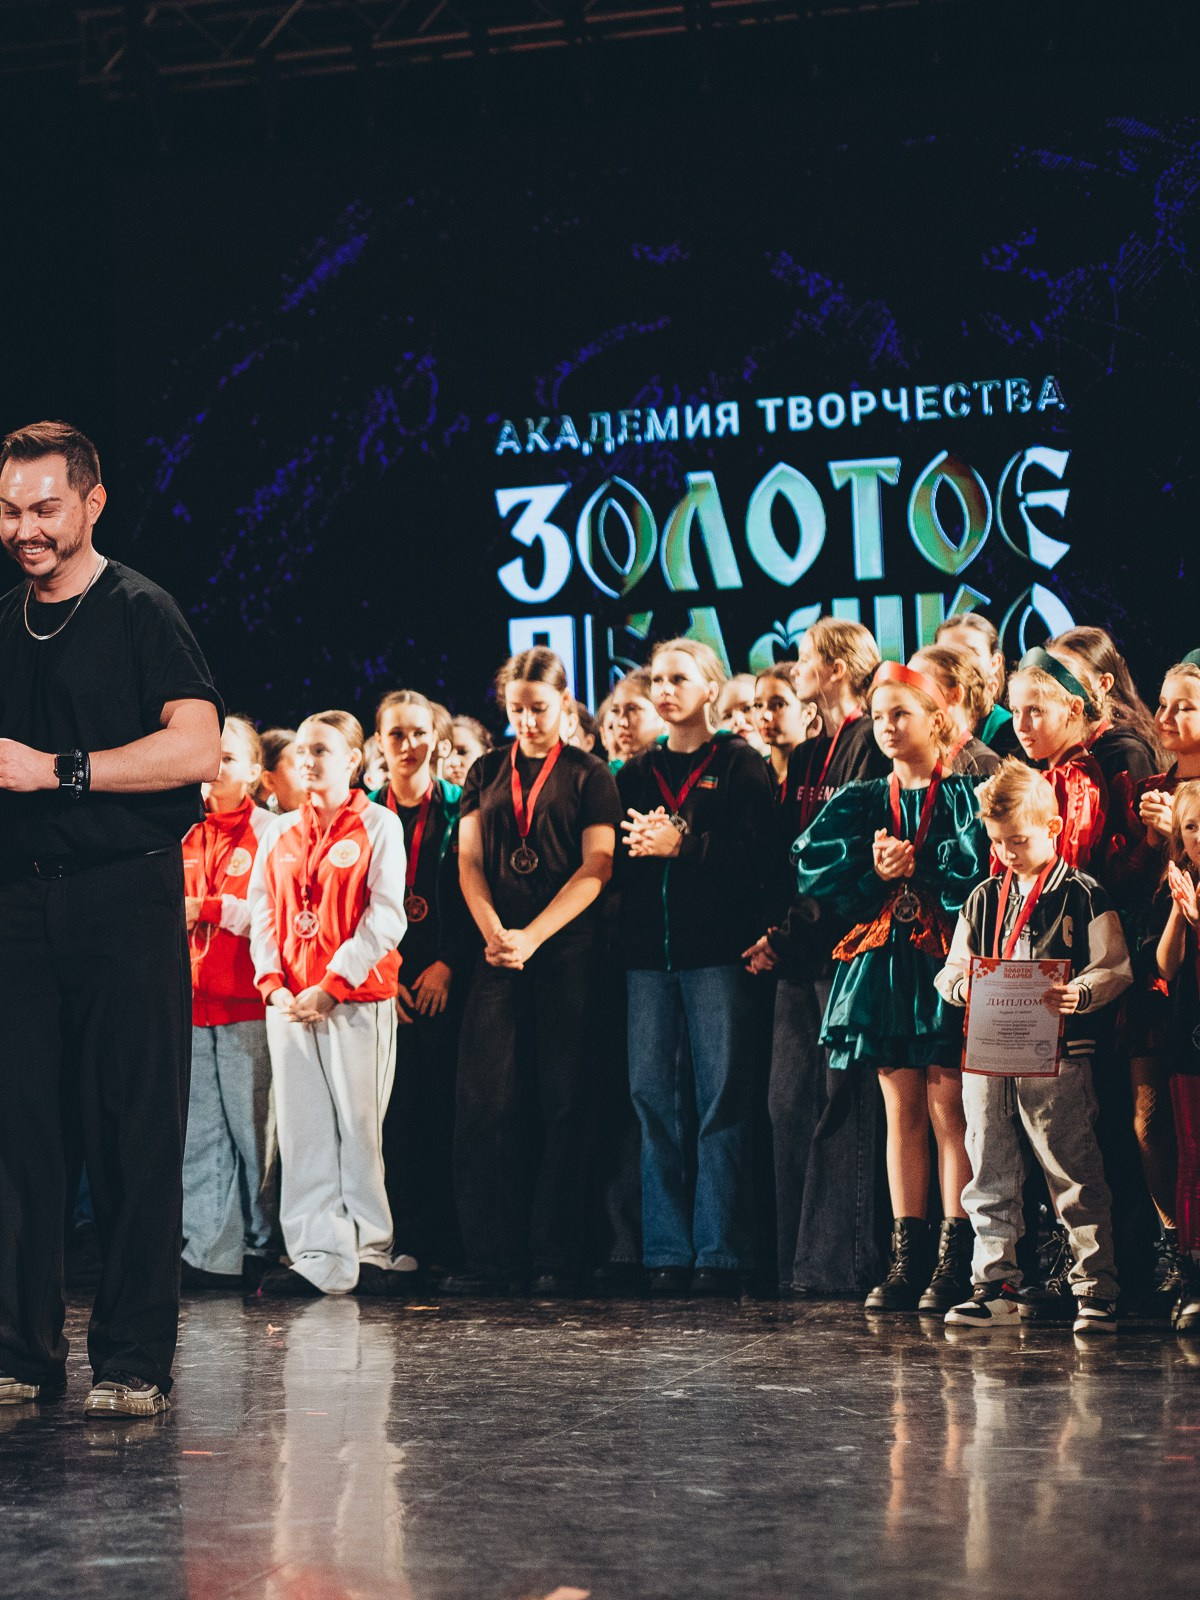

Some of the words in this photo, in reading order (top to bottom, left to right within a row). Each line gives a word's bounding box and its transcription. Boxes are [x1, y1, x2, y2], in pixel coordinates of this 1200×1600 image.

[495, 400, 740, 457] АКАДЕМИЯ
[757, 375, 1068, 433] ТВОРЧЕСТВА
[494, 445, 1071, 604] ЗОЛОТОЕ
[986, 998, 1042, 1006] ДИПЛОМ
